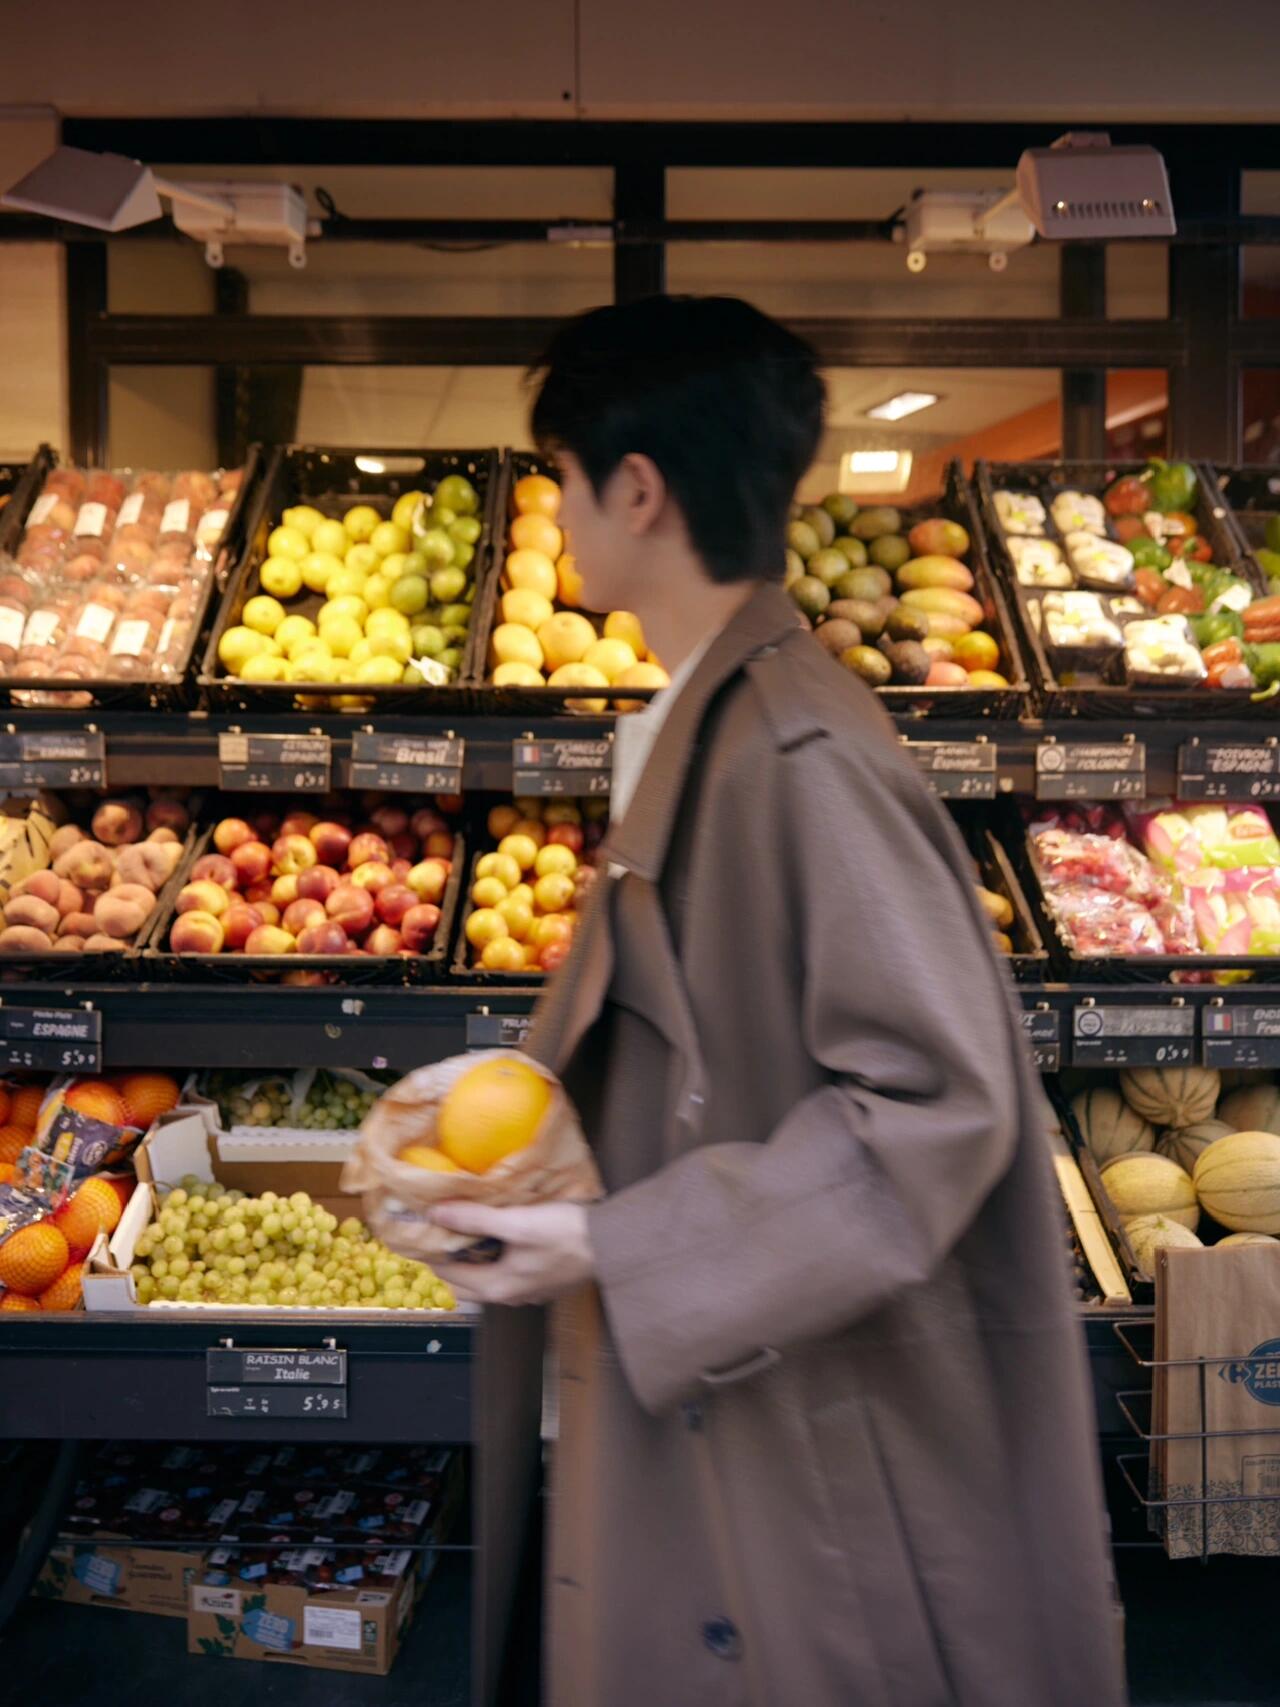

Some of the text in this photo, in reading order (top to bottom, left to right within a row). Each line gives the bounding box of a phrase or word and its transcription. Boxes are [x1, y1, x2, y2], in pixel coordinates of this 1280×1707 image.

[33, 1023, 88, 1037] ESPAGNE
[246, 1355, 338, 1365] RAISIN BLANC
[274, 1368, 310, 1380] Italie
